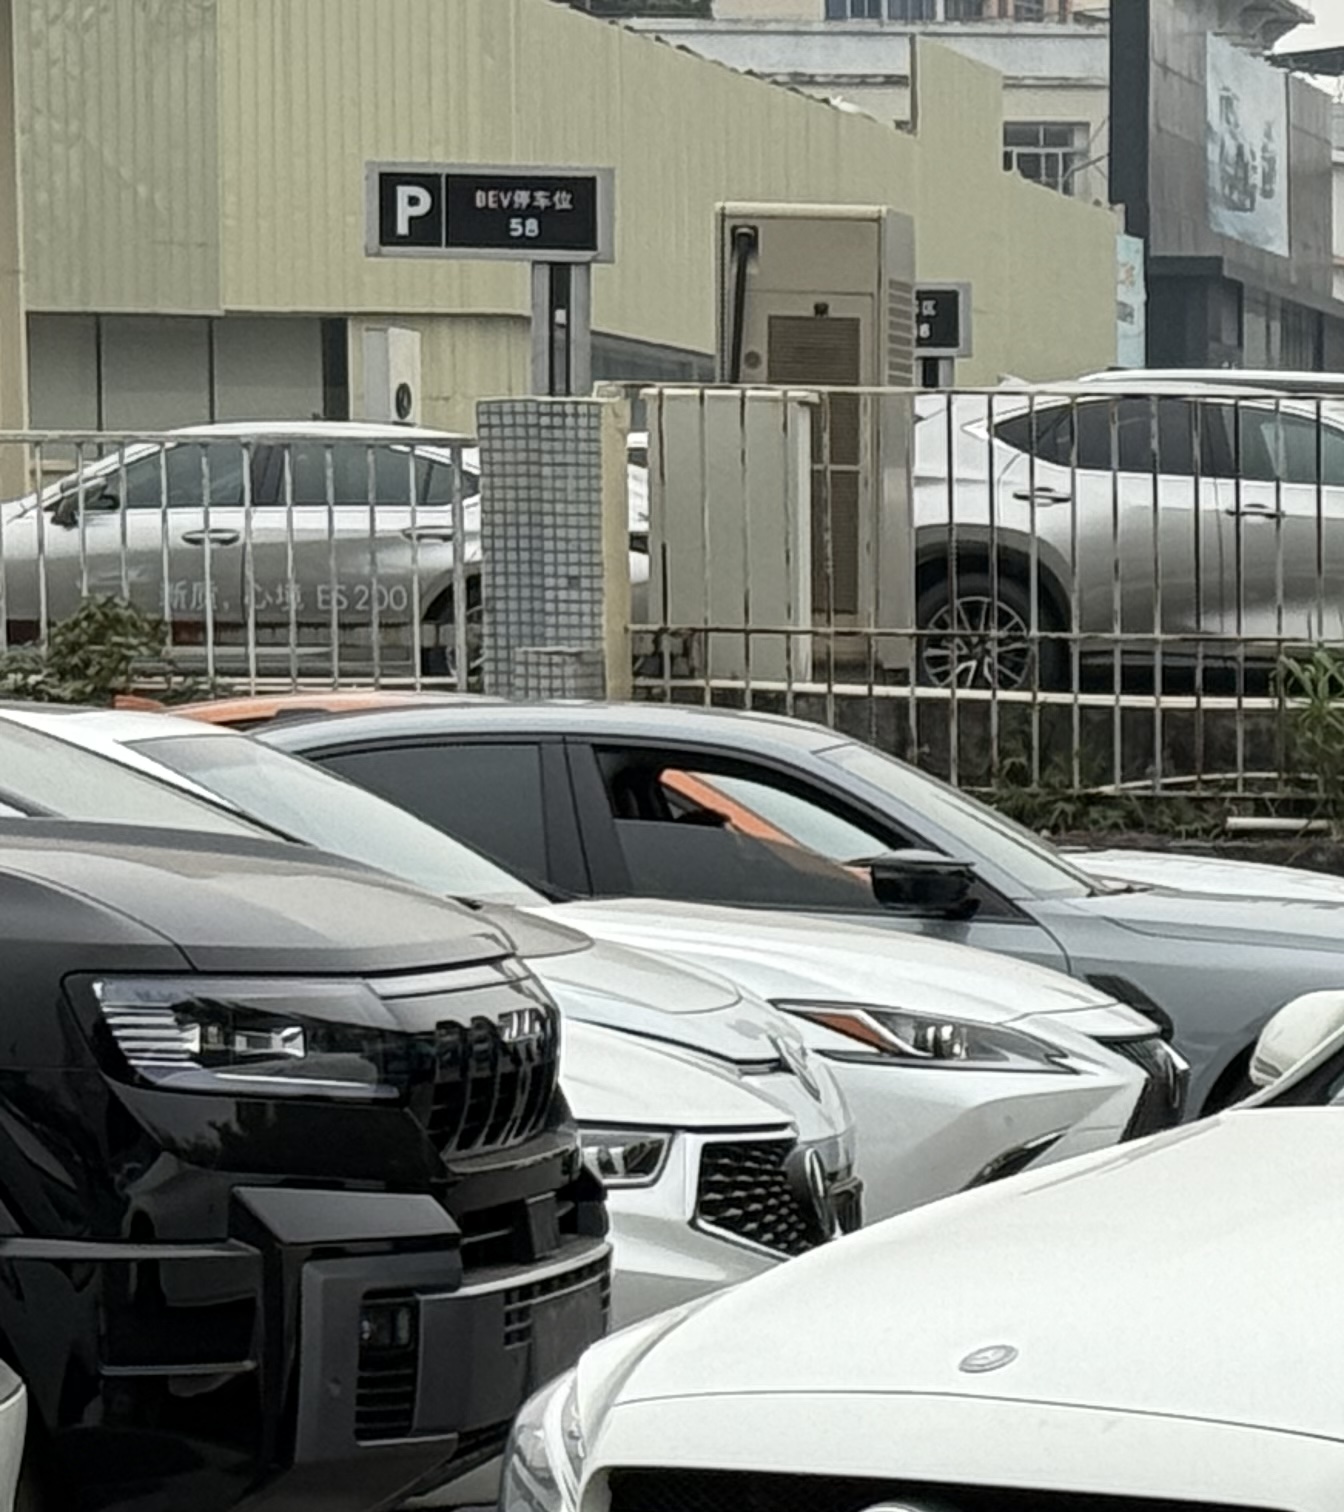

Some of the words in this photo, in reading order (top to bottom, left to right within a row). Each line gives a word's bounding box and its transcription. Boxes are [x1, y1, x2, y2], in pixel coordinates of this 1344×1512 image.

[396, 185, 432, 236] P
[509, 218, 540, 237] 58
[353, 584, 408, 611] 200
